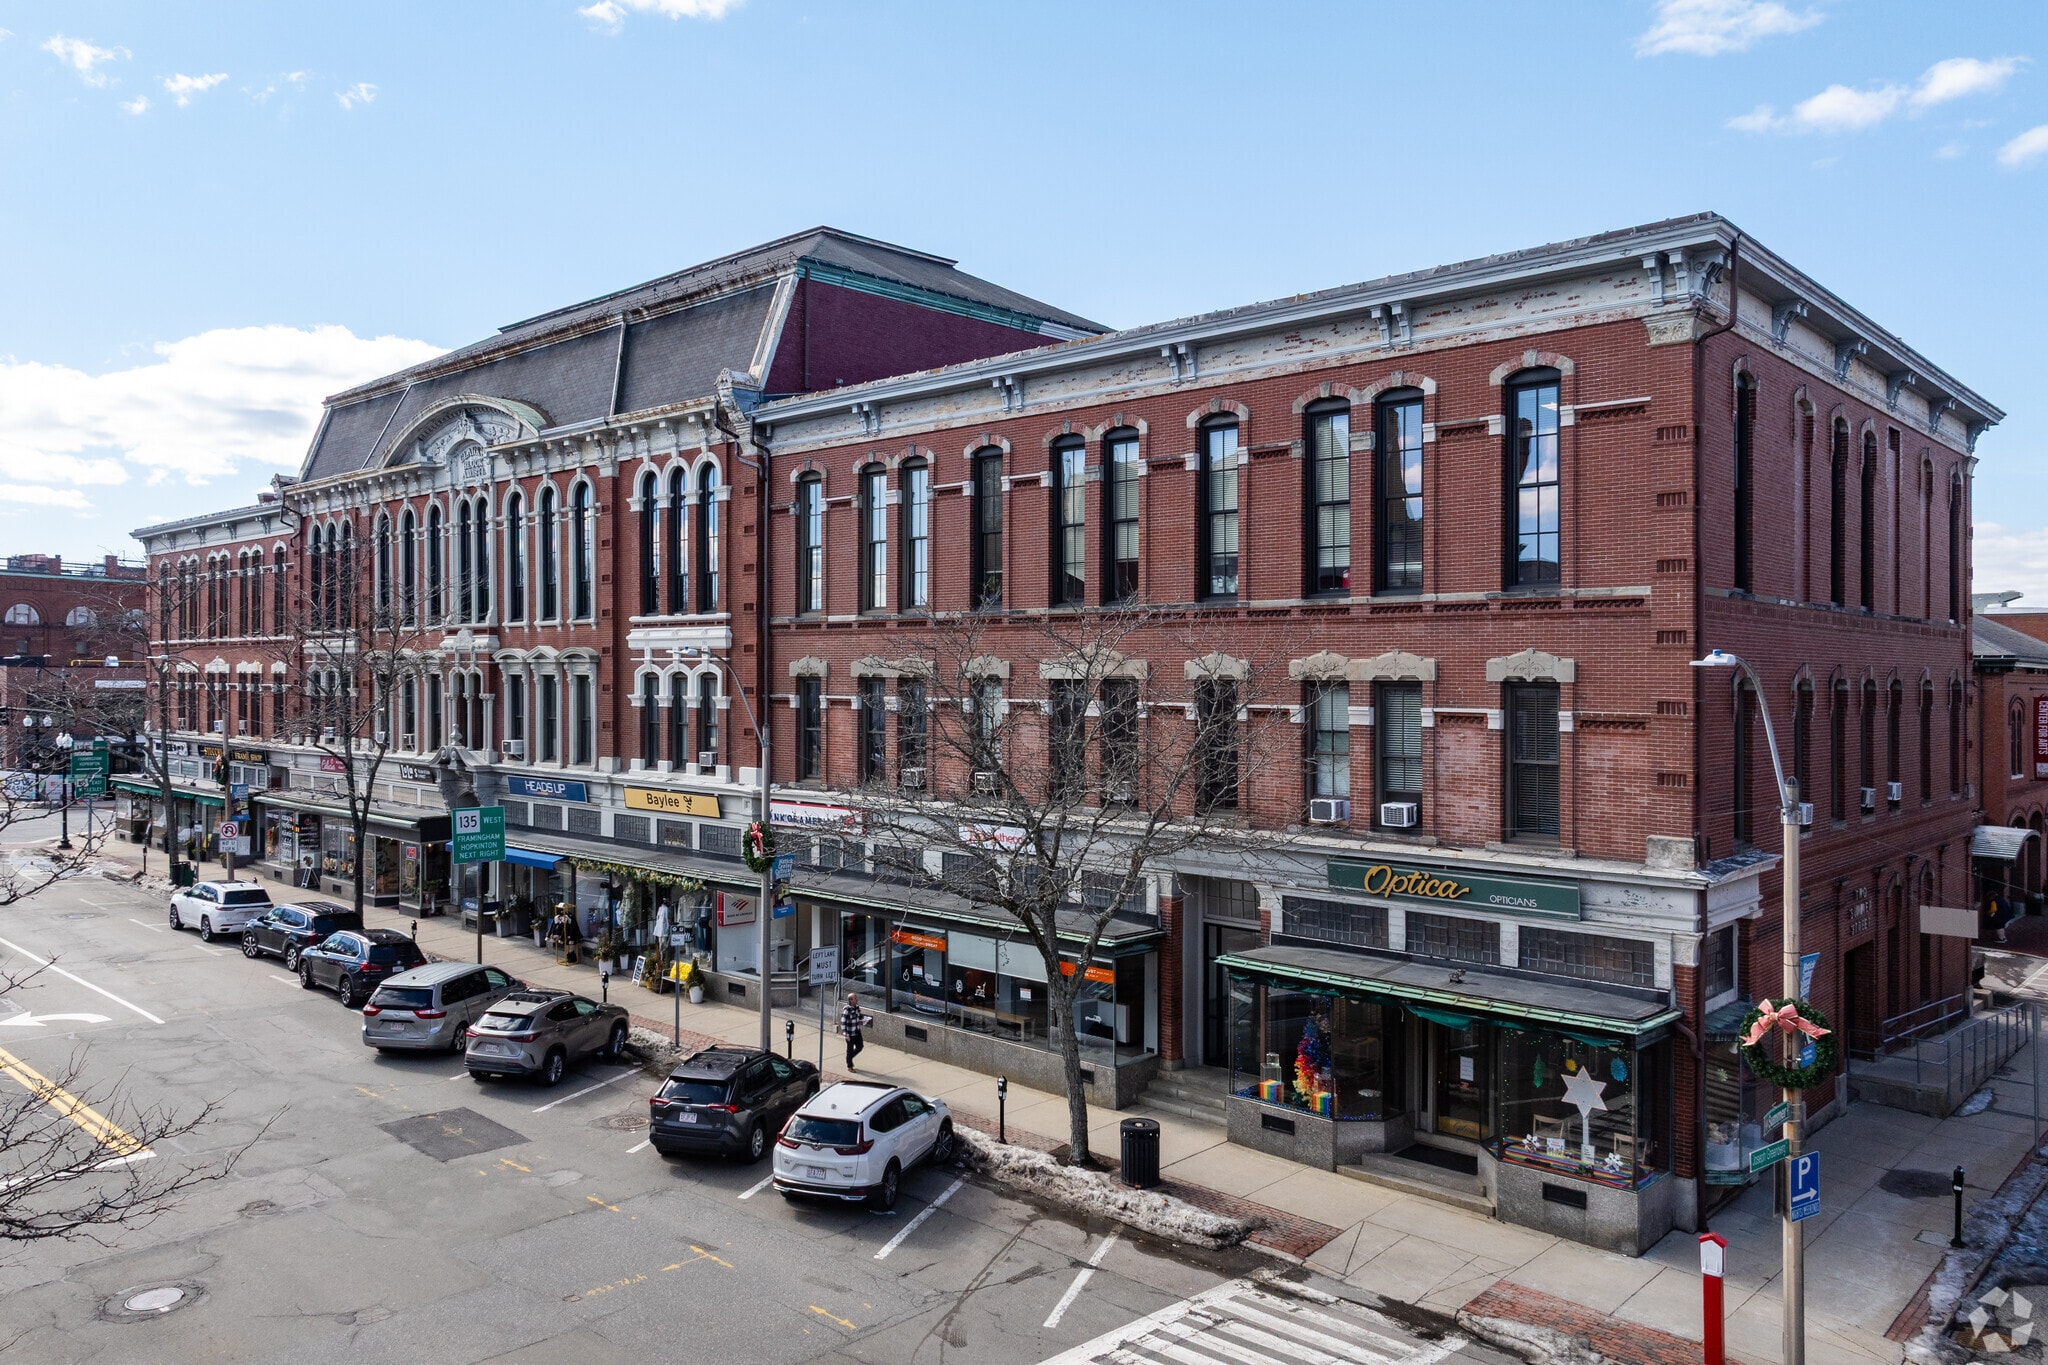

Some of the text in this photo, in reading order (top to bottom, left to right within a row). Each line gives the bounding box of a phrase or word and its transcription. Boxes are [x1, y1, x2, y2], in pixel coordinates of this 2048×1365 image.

[525, 780, 566, 794] HEADS UP
[646, 793, 680, 808] Baylee
[459, 815, 502, 828] 135 WEST
[457, 833, 501, 843] FRAMINGHAM
[460, 842, 498, 851] HOPKINTON
[459, 850, 499, 859] NEXT RIGHT
[1363, 865, 1470, 899] Optica
[1855, 886, 1868, 900] TWO
[1489, 894, 1537, 908] OPTICIANS
[812, 950, 836, 959] LEFT LANE
[816, 960, 832, 970] MUST
[1798, 1156, 1811, 1190] P
